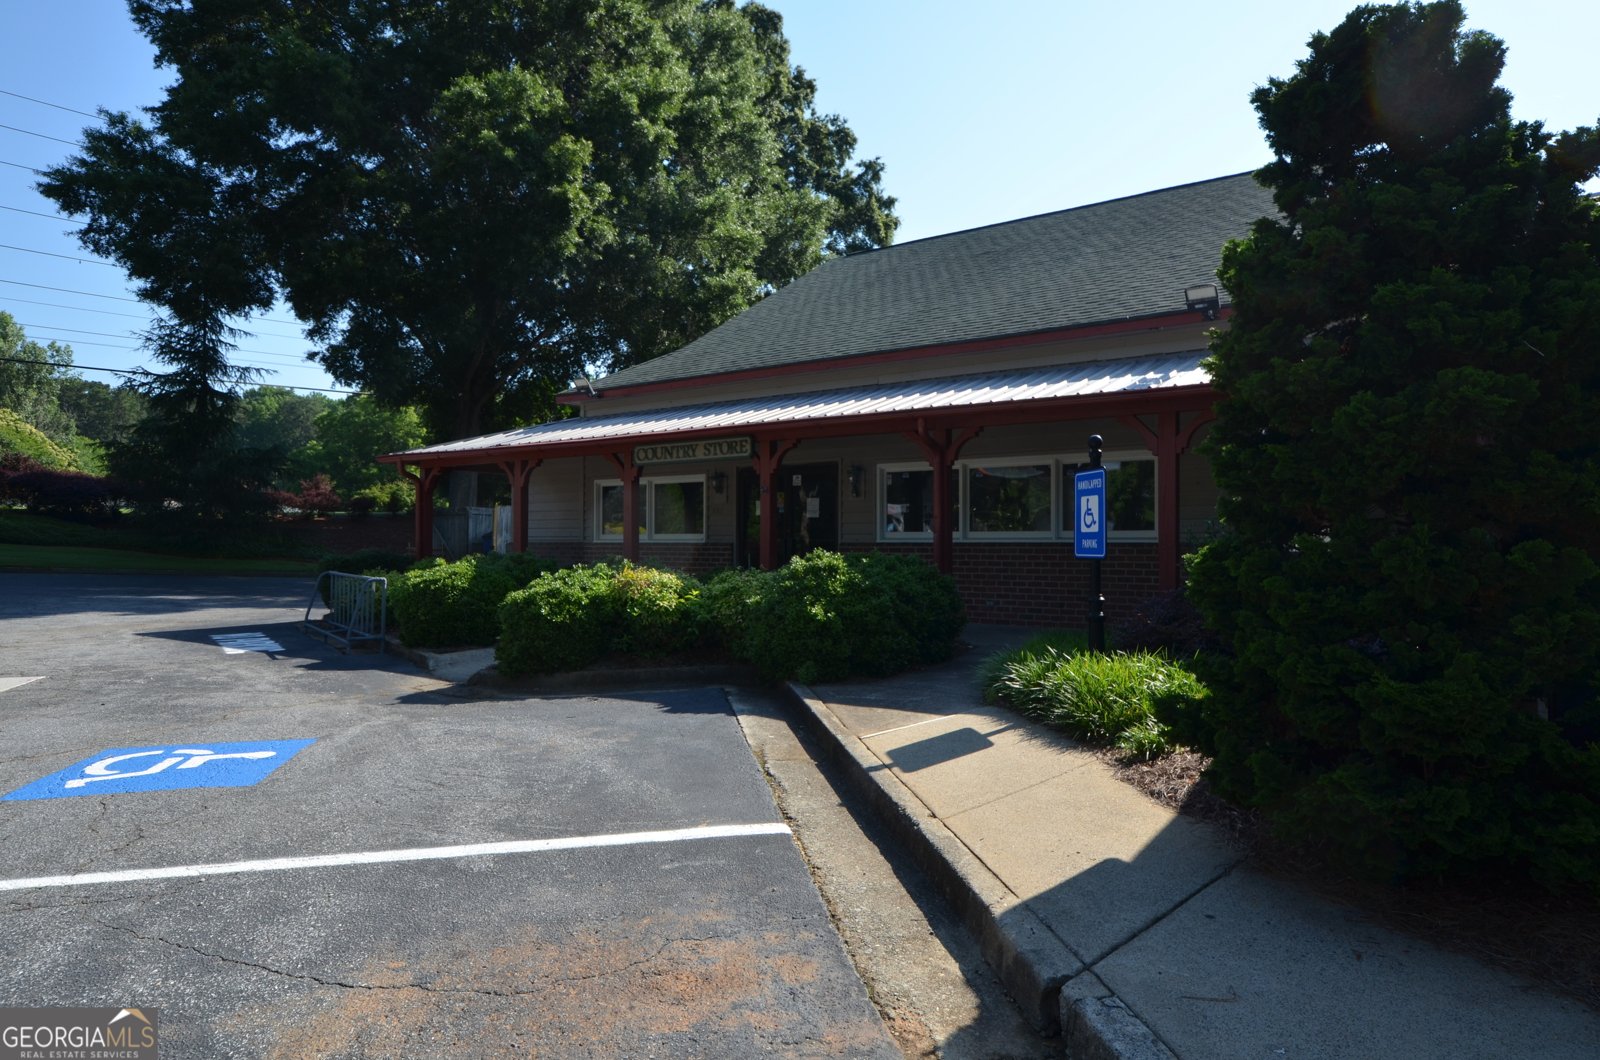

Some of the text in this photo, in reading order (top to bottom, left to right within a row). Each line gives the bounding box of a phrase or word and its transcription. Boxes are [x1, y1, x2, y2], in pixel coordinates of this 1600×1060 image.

[636, 438, 749, 461] COUNTRY STORE
[1081, 538, 1098, 549] PARKING
